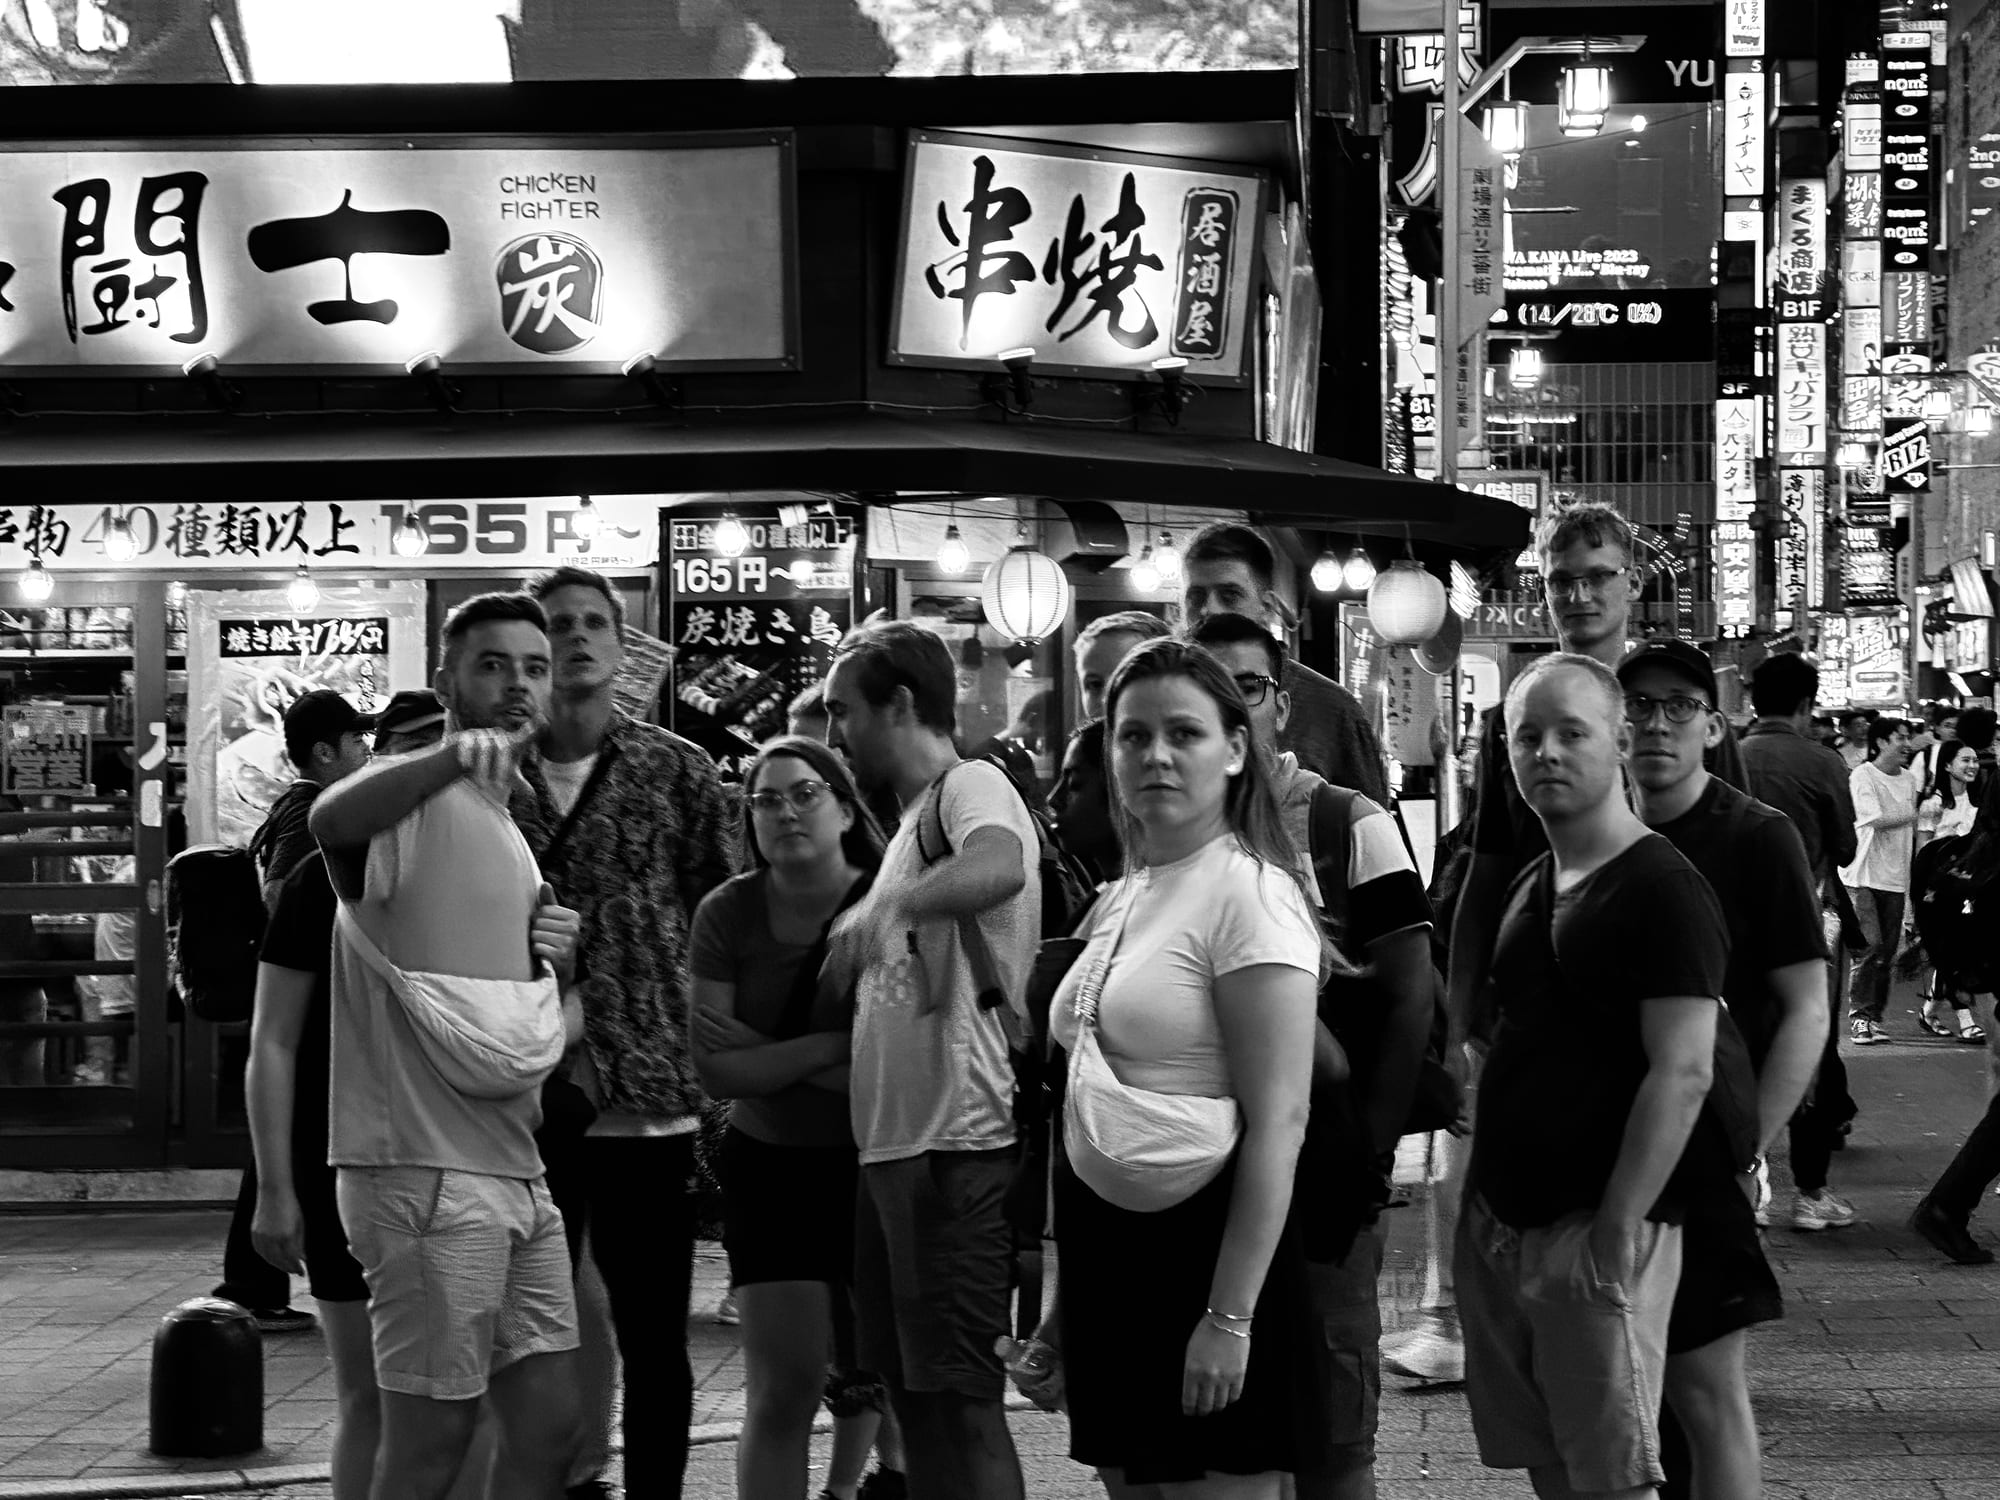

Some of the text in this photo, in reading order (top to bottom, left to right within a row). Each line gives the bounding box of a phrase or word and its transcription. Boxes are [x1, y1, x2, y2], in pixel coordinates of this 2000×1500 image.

[1751, 0, 1759, 22] ラオケ
[1665, 59, 1715, 87] YU
[500, 172, 597, 194] CHICKEN
[501, 199, 600, 220] FIGHTER
[0, 170, 451, 345] 闘士
[925, 154, 1164, 351] 串焼
[1603, 250, 1638, 263] 2023
[1178, 202, 1226, 347] 居酒屋
[503, 238, 600, 342] 炭
[1783, 300, 1823, 318] B1F
[1722, 383, 1751, 395] 3F
[1790, 453, 1815, 466] 4F
[1457, 482, 1538, 510] 時間
[1718, 523, 1756, 540] 焼肉
[680, 605, 843, 648] 炭焼き鳥
[1722, 625, 1751, 639] 2F
